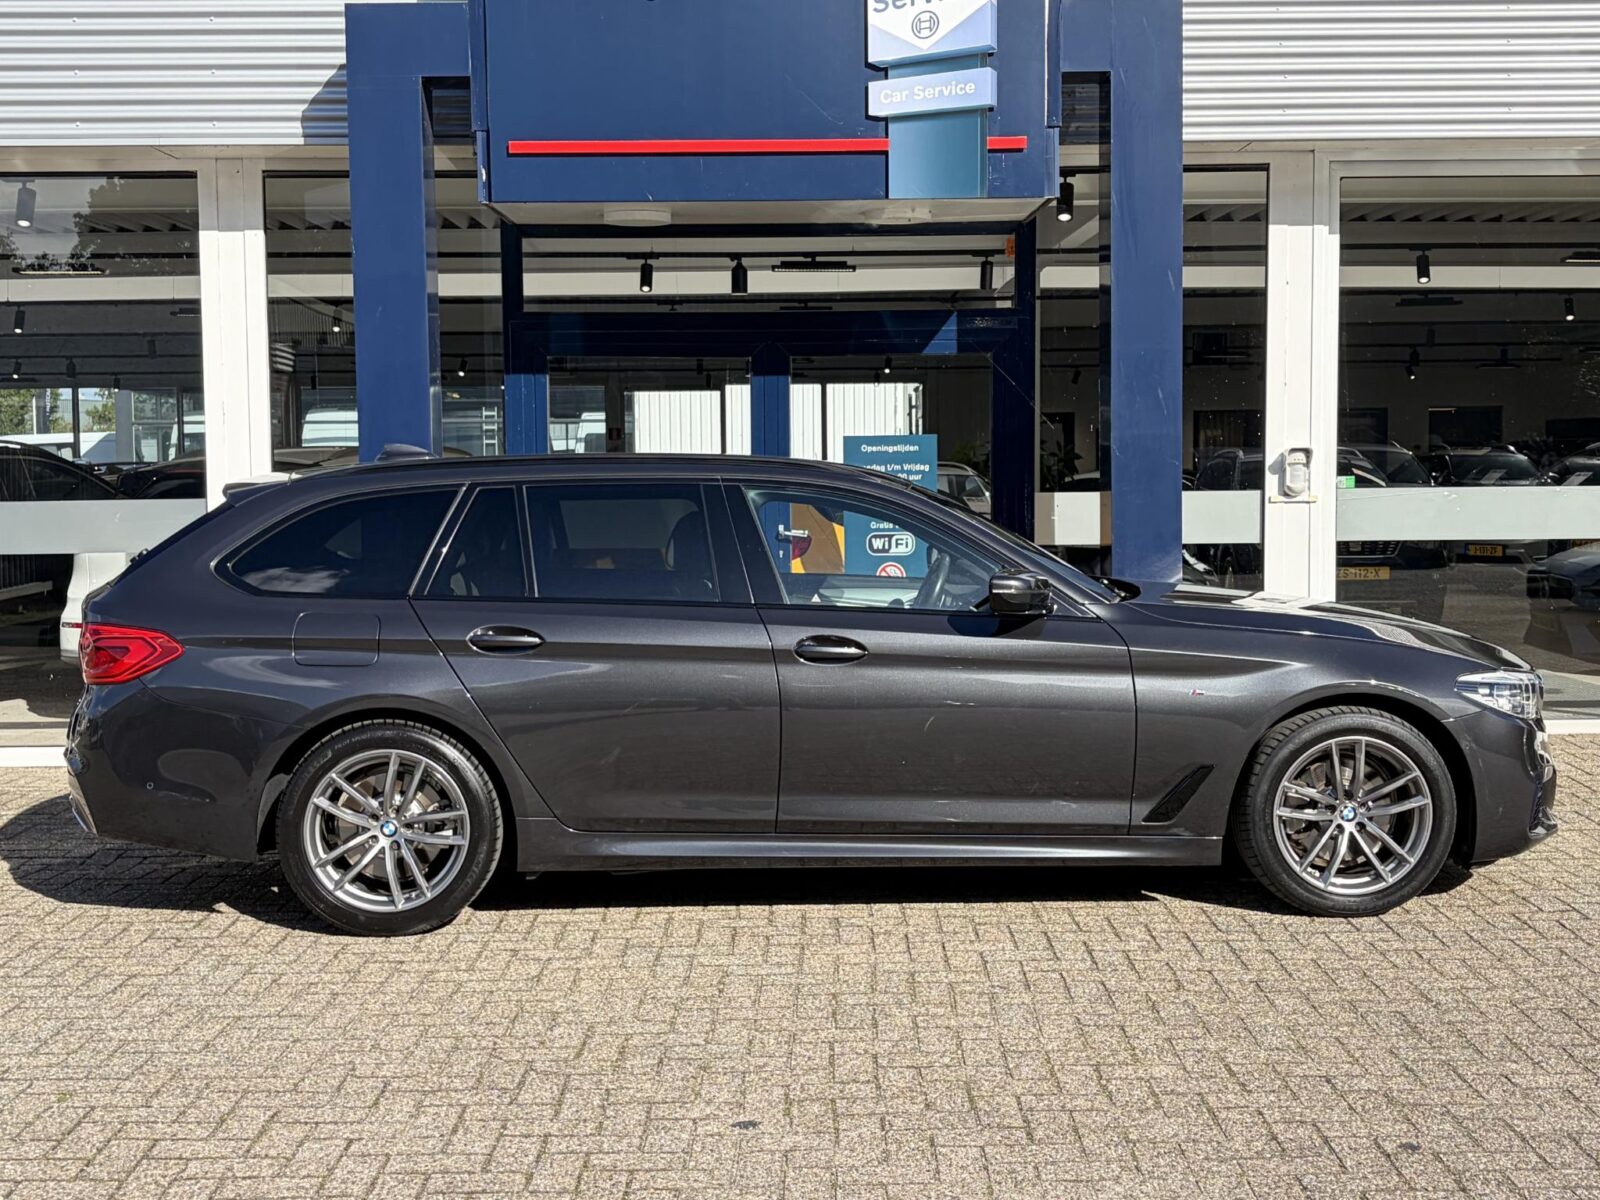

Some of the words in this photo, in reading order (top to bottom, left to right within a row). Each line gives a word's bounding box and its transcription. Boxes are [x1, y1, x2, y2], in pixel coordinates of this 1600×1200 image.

[880, 89, 909, 104] Car
[913, 81, 976, 100] Service
[861, 444, 919, 453] Openingstijden
[887, 463, 902, 471] t/m
[903, 463, 930, 472] Vrijdag
